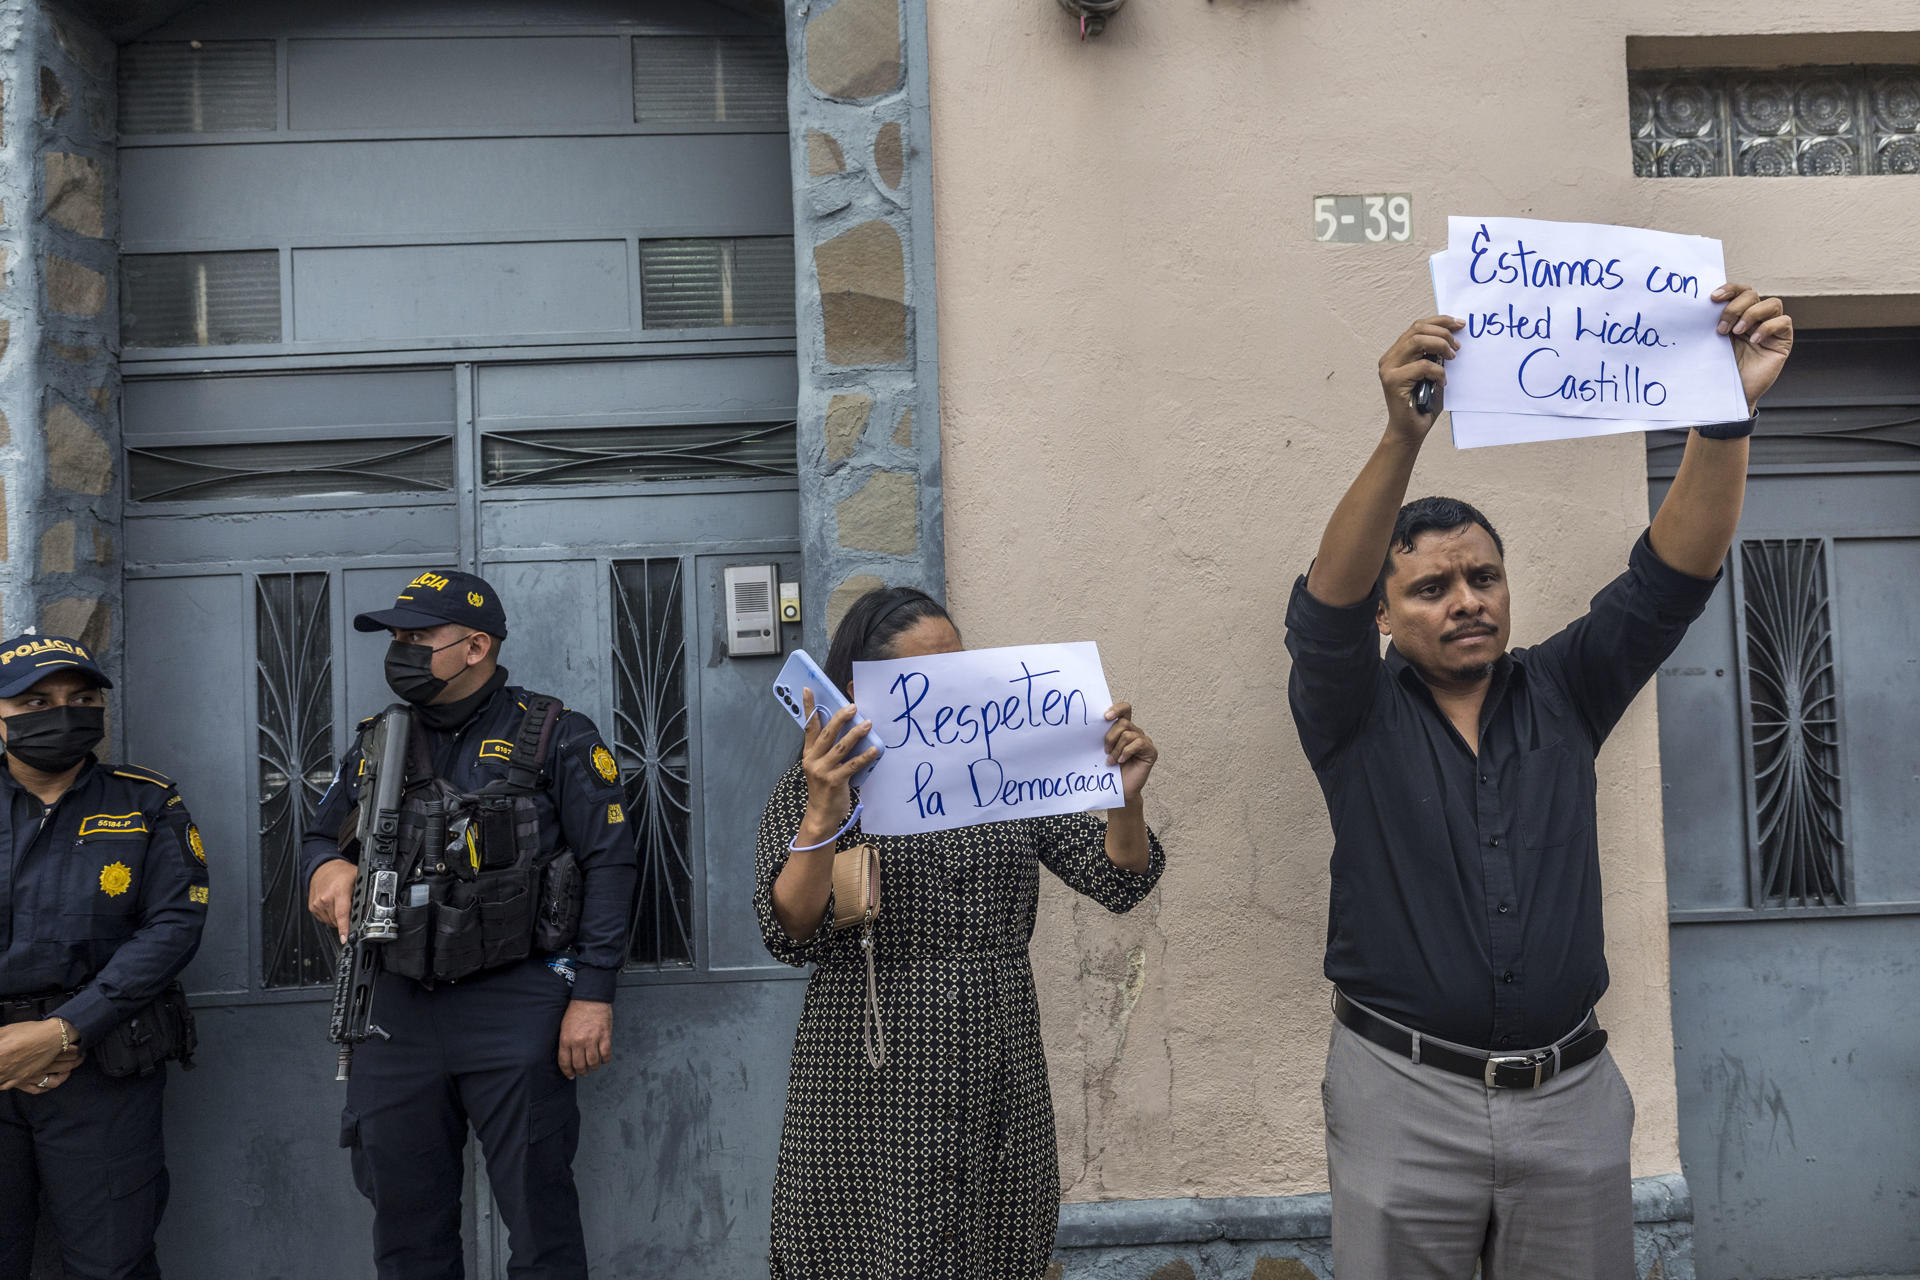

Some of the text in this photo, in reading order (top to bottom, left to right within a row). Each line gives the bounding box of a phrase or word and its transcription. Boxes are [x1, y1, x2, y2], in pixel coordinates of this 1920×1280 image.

[1315, 197, 1410, 241] 5-39
[1469, 224, 1698, 299] Estamos con
[1469, 303, 1551, 340] usted
[1518, 347, 1667, 406] Castillo
[411, 572, 449, 591] LICIA
[0, 639, 90, 665] POLICIA
[885, 661, 1088, 760] Respeten
[906, 757, 1119, 819] la Democracia
